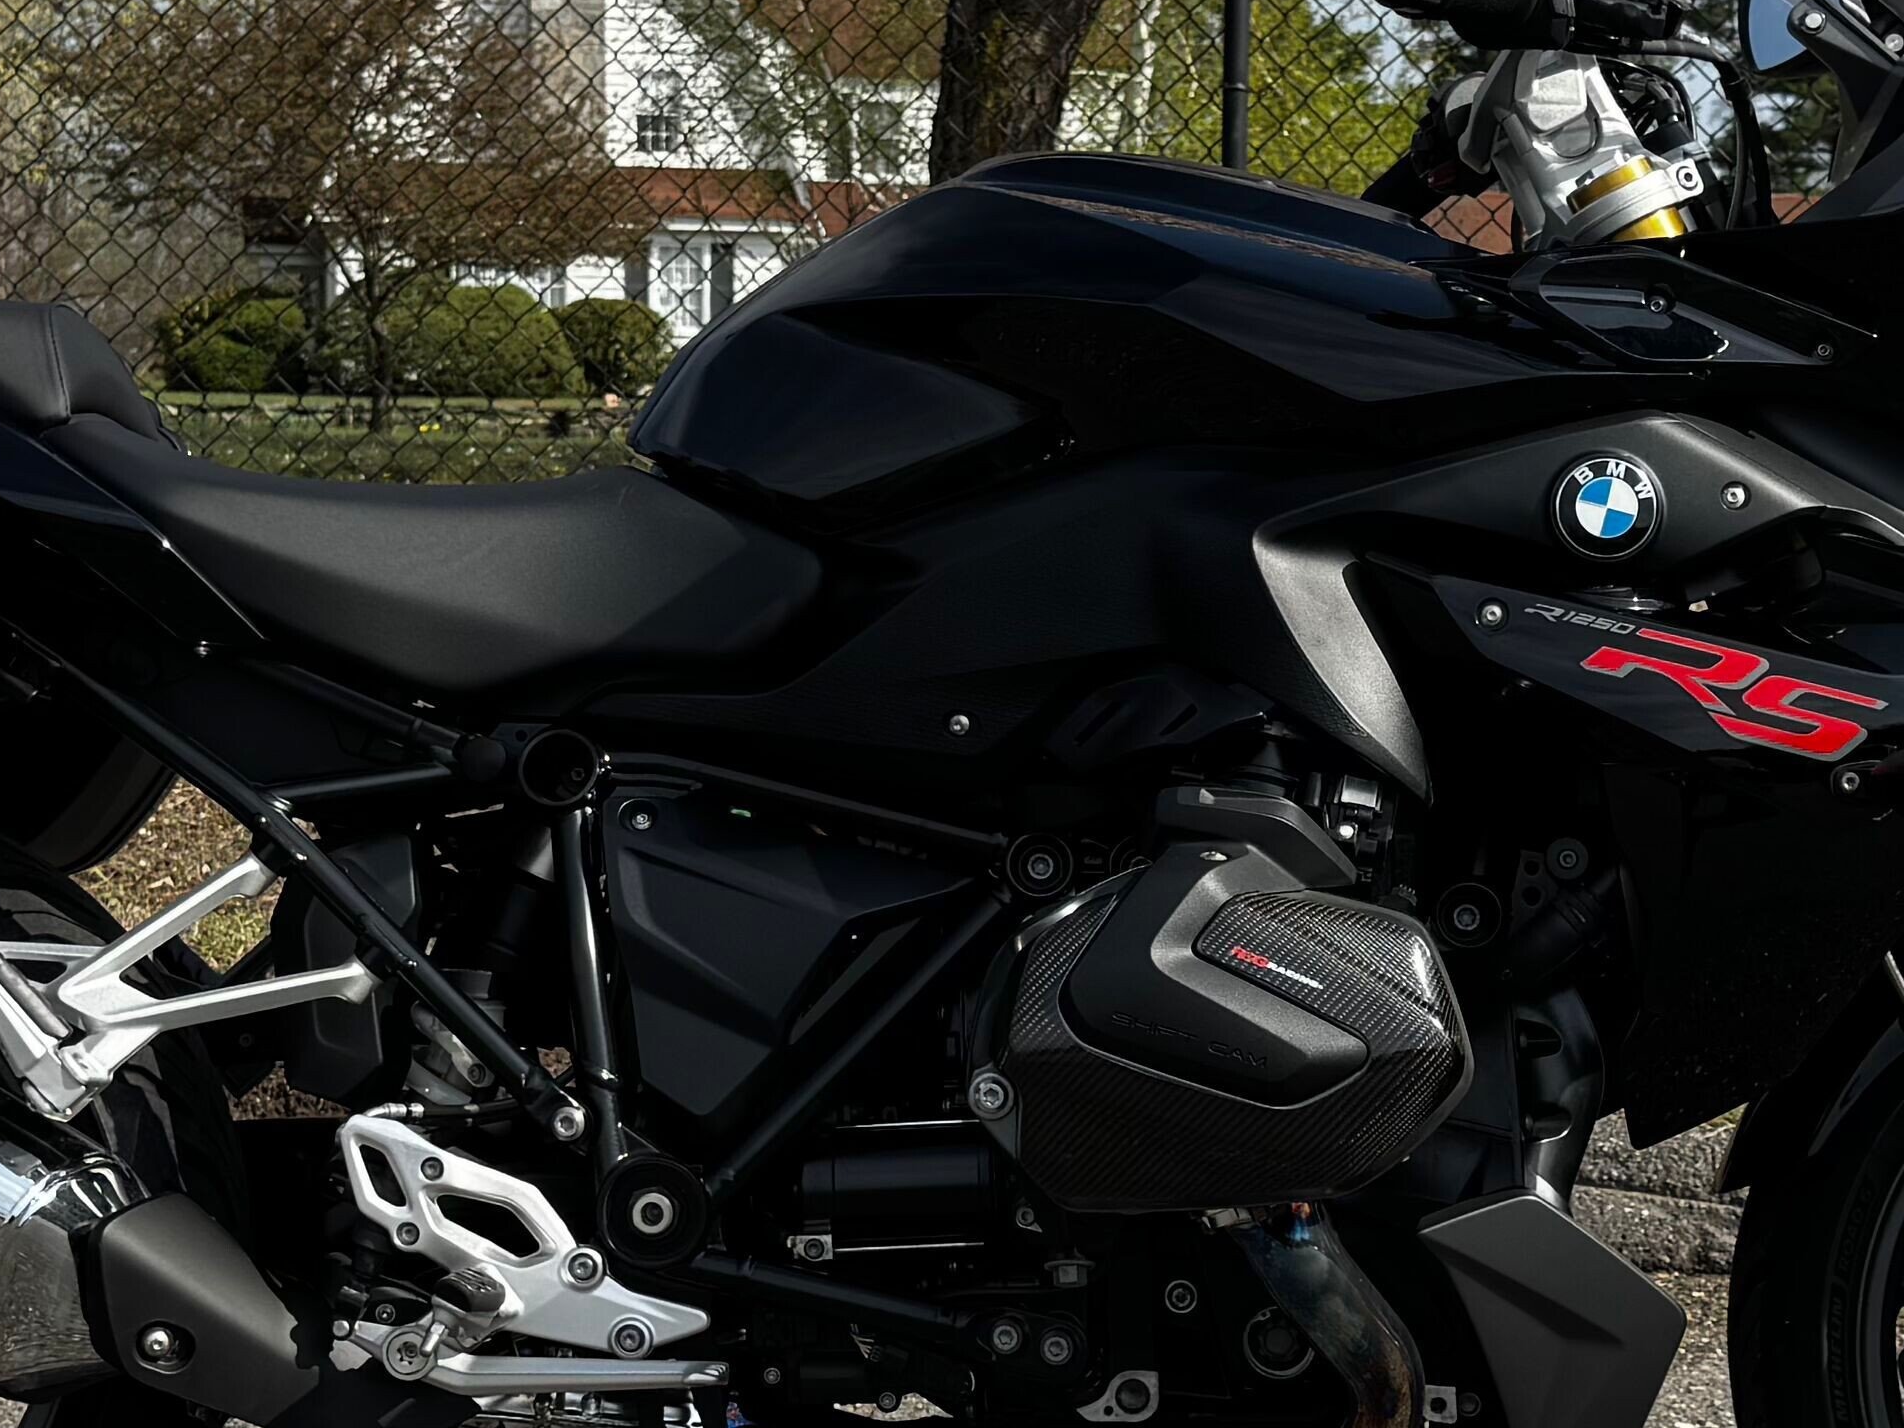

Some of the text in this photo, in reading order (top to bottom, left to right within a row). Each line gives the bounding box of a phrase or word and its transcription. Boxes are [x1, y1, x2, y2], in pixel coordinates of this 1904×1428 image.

[1573, 460, 1654, 500] BMW
[1580, 628, 1889, 762] RS
[1111, 1010, 1267, 1068] SHIFT CAM
[1828, 1296, 1850, 1423] MICHELIN
